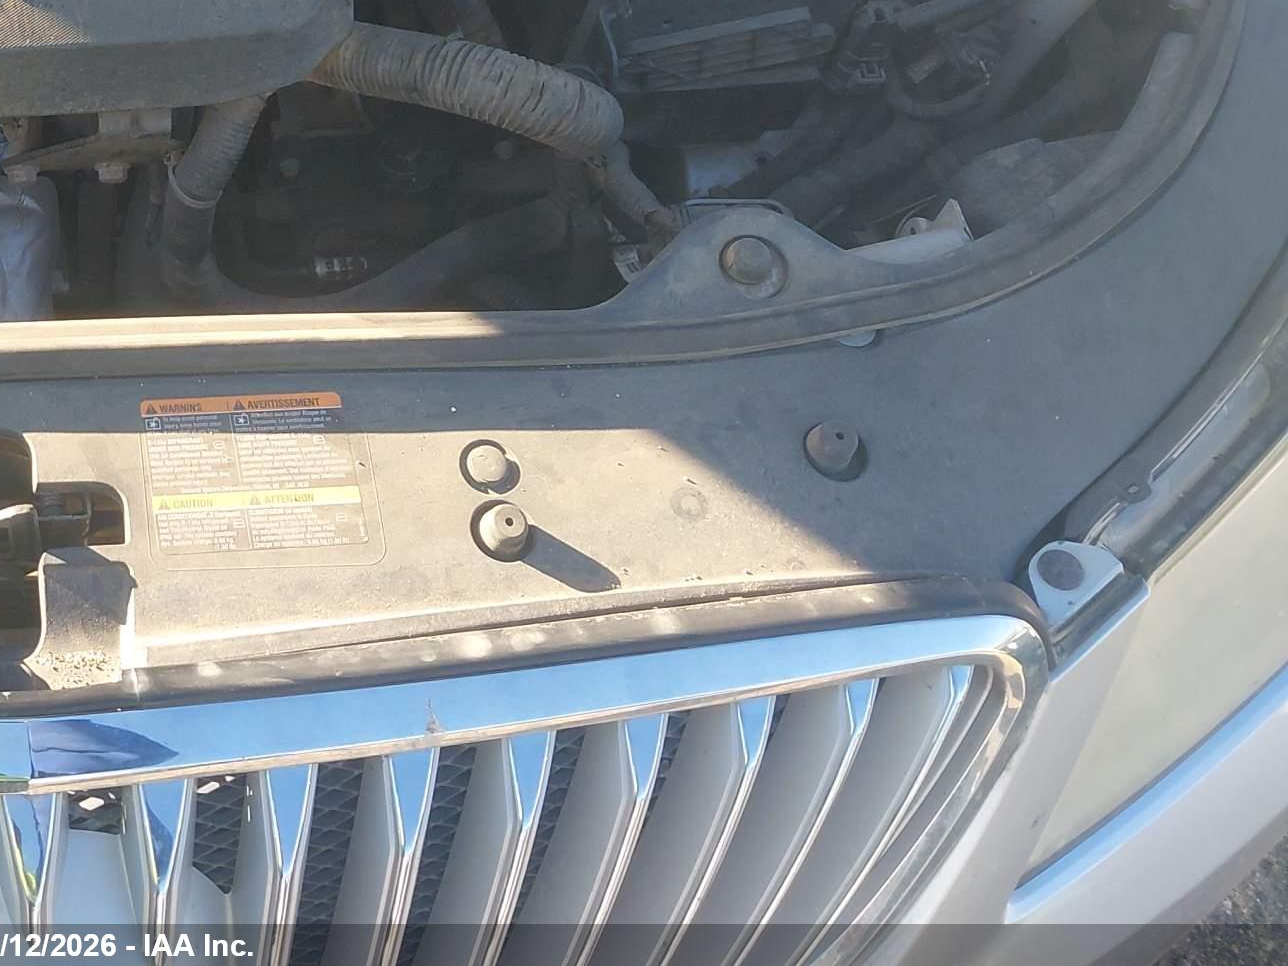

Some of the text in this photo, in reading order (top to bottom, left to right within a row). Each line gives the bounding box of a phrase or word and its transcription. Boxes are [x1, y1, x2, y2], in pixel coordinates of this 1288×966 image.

[159, 402, 202, 413] WARNING
[247, 397, 321, 411] AVERTISSEMENT
[173, 498, 214, 509] CAUTION
